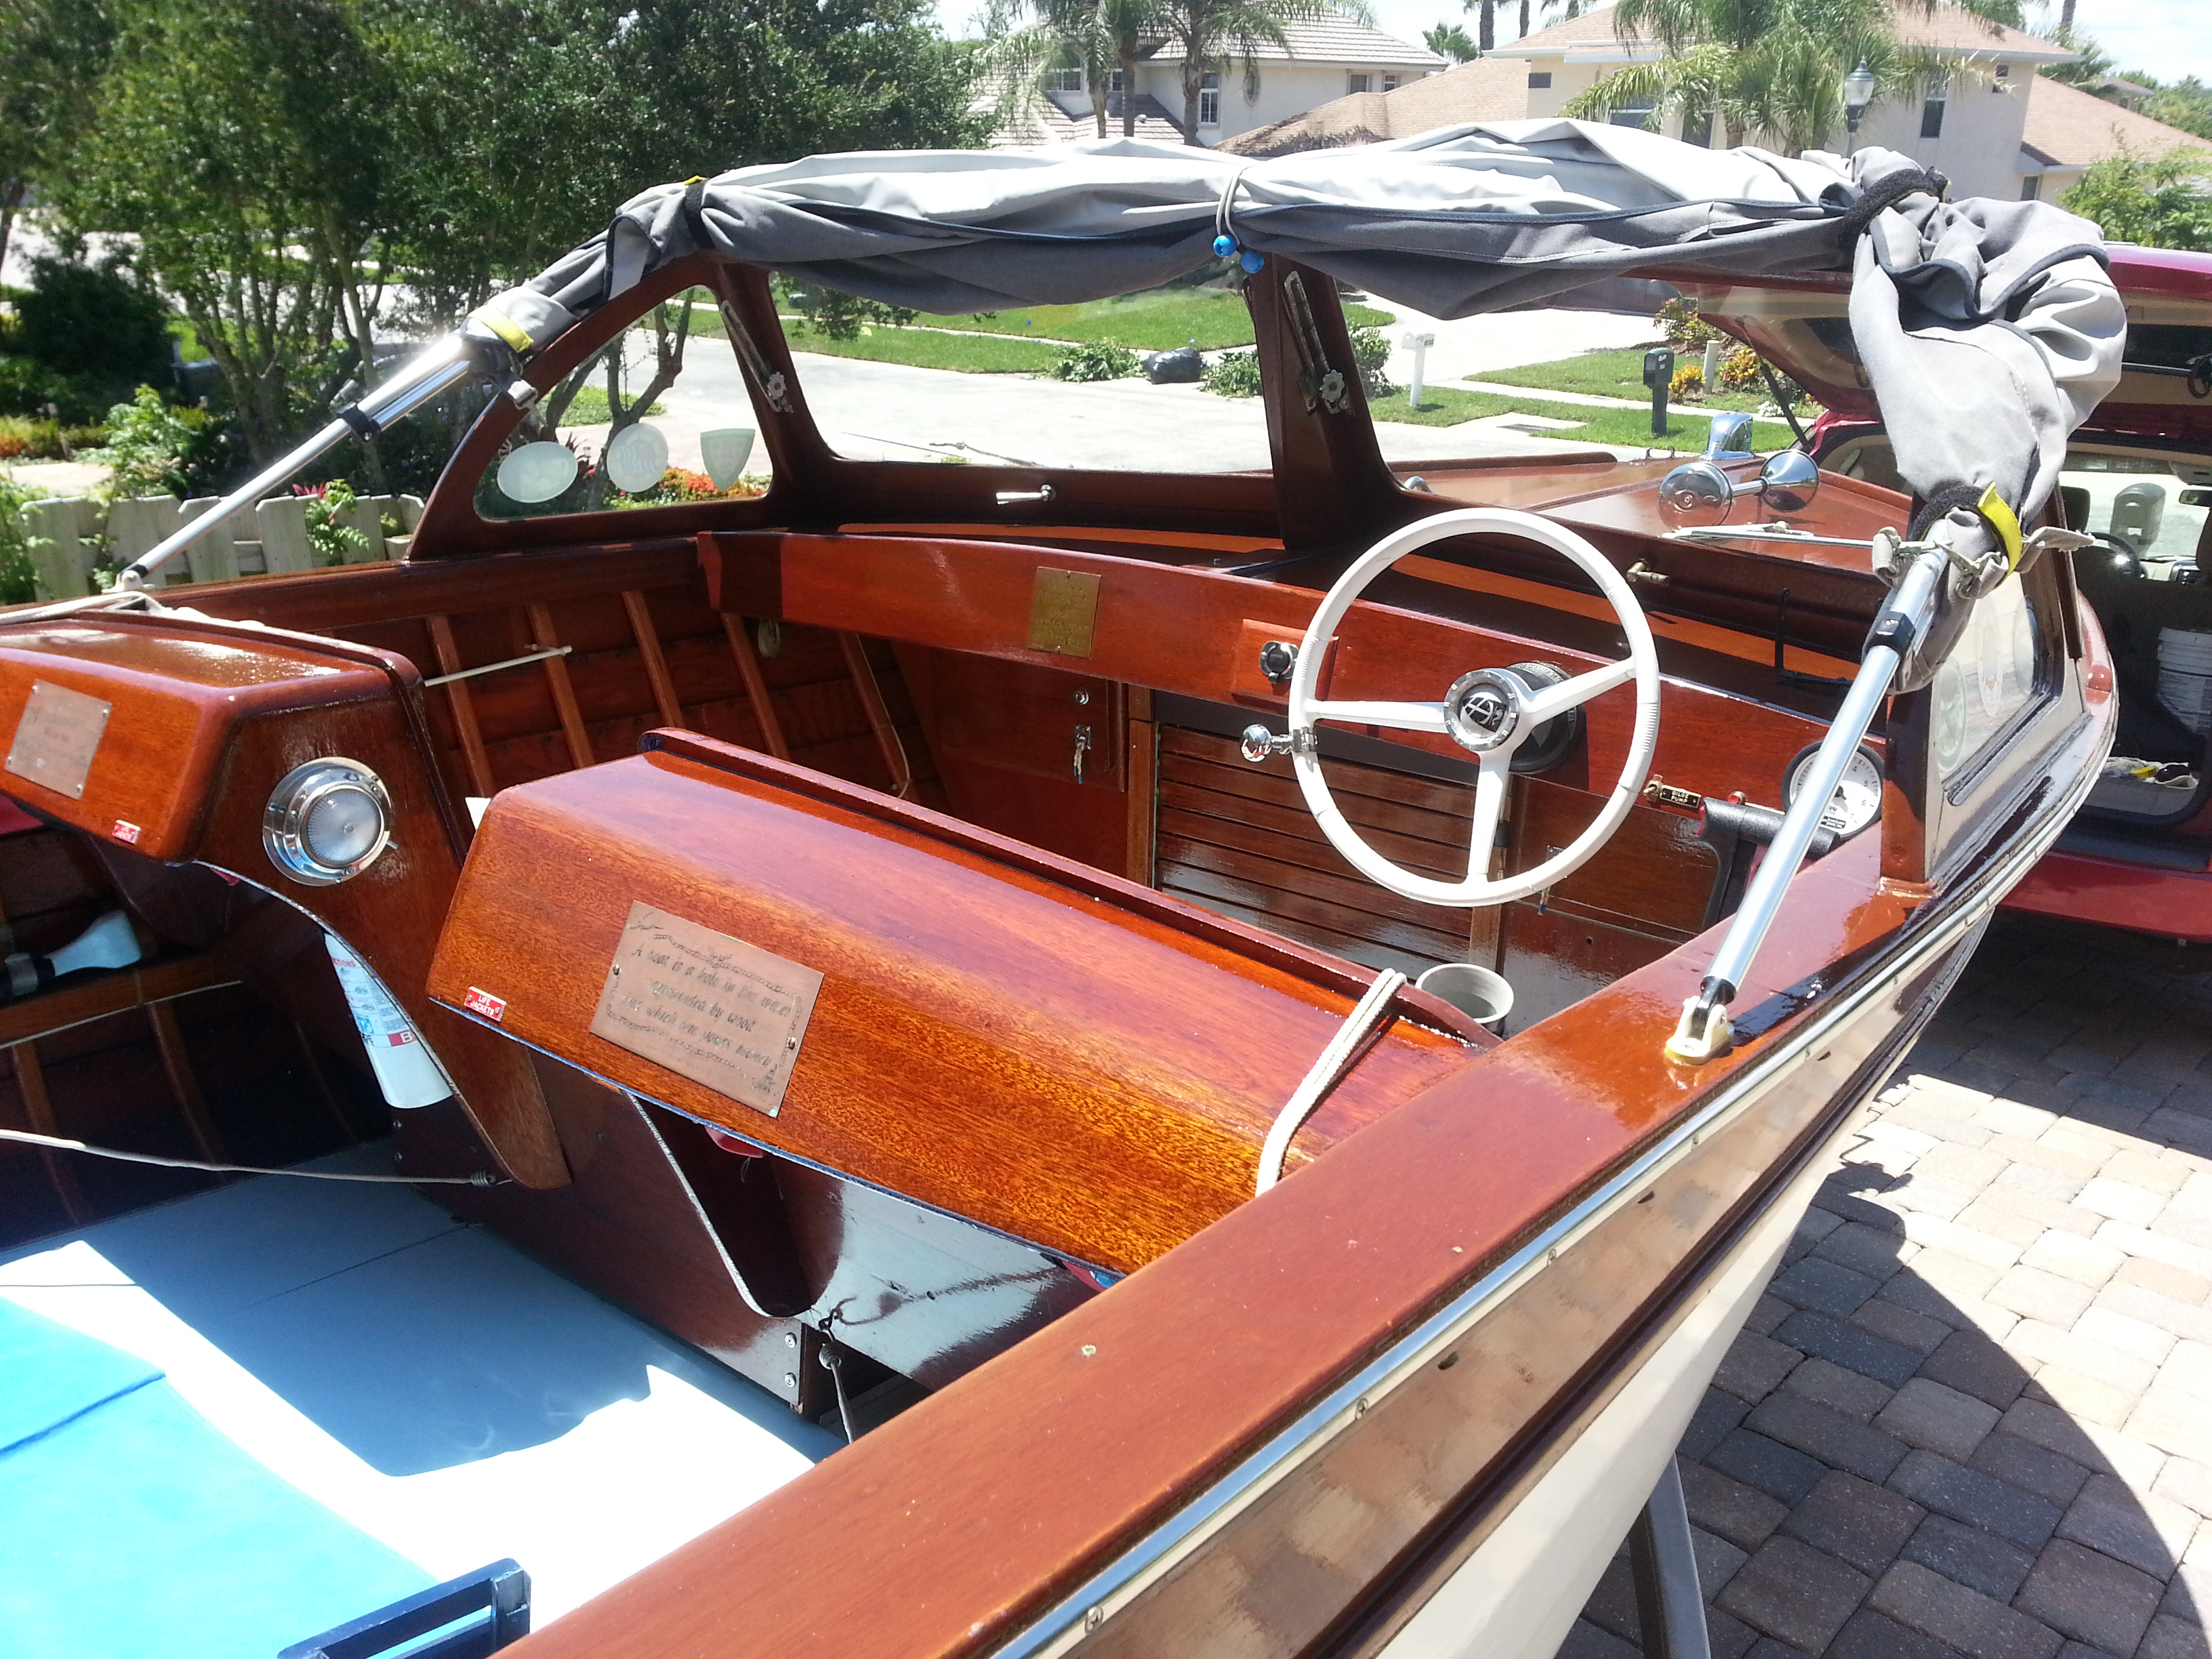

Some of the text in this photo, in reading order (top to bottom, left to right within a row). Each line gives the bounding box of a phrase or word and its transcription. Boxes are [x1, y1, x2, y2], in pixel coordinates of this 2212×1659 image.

[1671, 796, 1687, 804] PUMP
[1672, 791, 1689, 799] BILGE
[631, 943, 644, 957] A
[647, 949, 670, 966] boat
[672, 957, 683, 972] is
[685, 966, 695, 976] a
[697, 967, 720, 987] hole
[723, 978, 736, 993] in
[761, 996, 792, 1017] water
[478, 994, 491, 1006] LIFE
[470, 1000, 495, 1016] JACKETS
[710, 1002, 724, 1023] by
[727, 1012, 757, 1032] wood
[400, 1031, 413, 1044] B
[646, 1005, 678, 1026] which
[679, 1021, 699, 1036] one
[699, 1031, 732, 1048] pours
[735, 1044, 771, 1068] money
